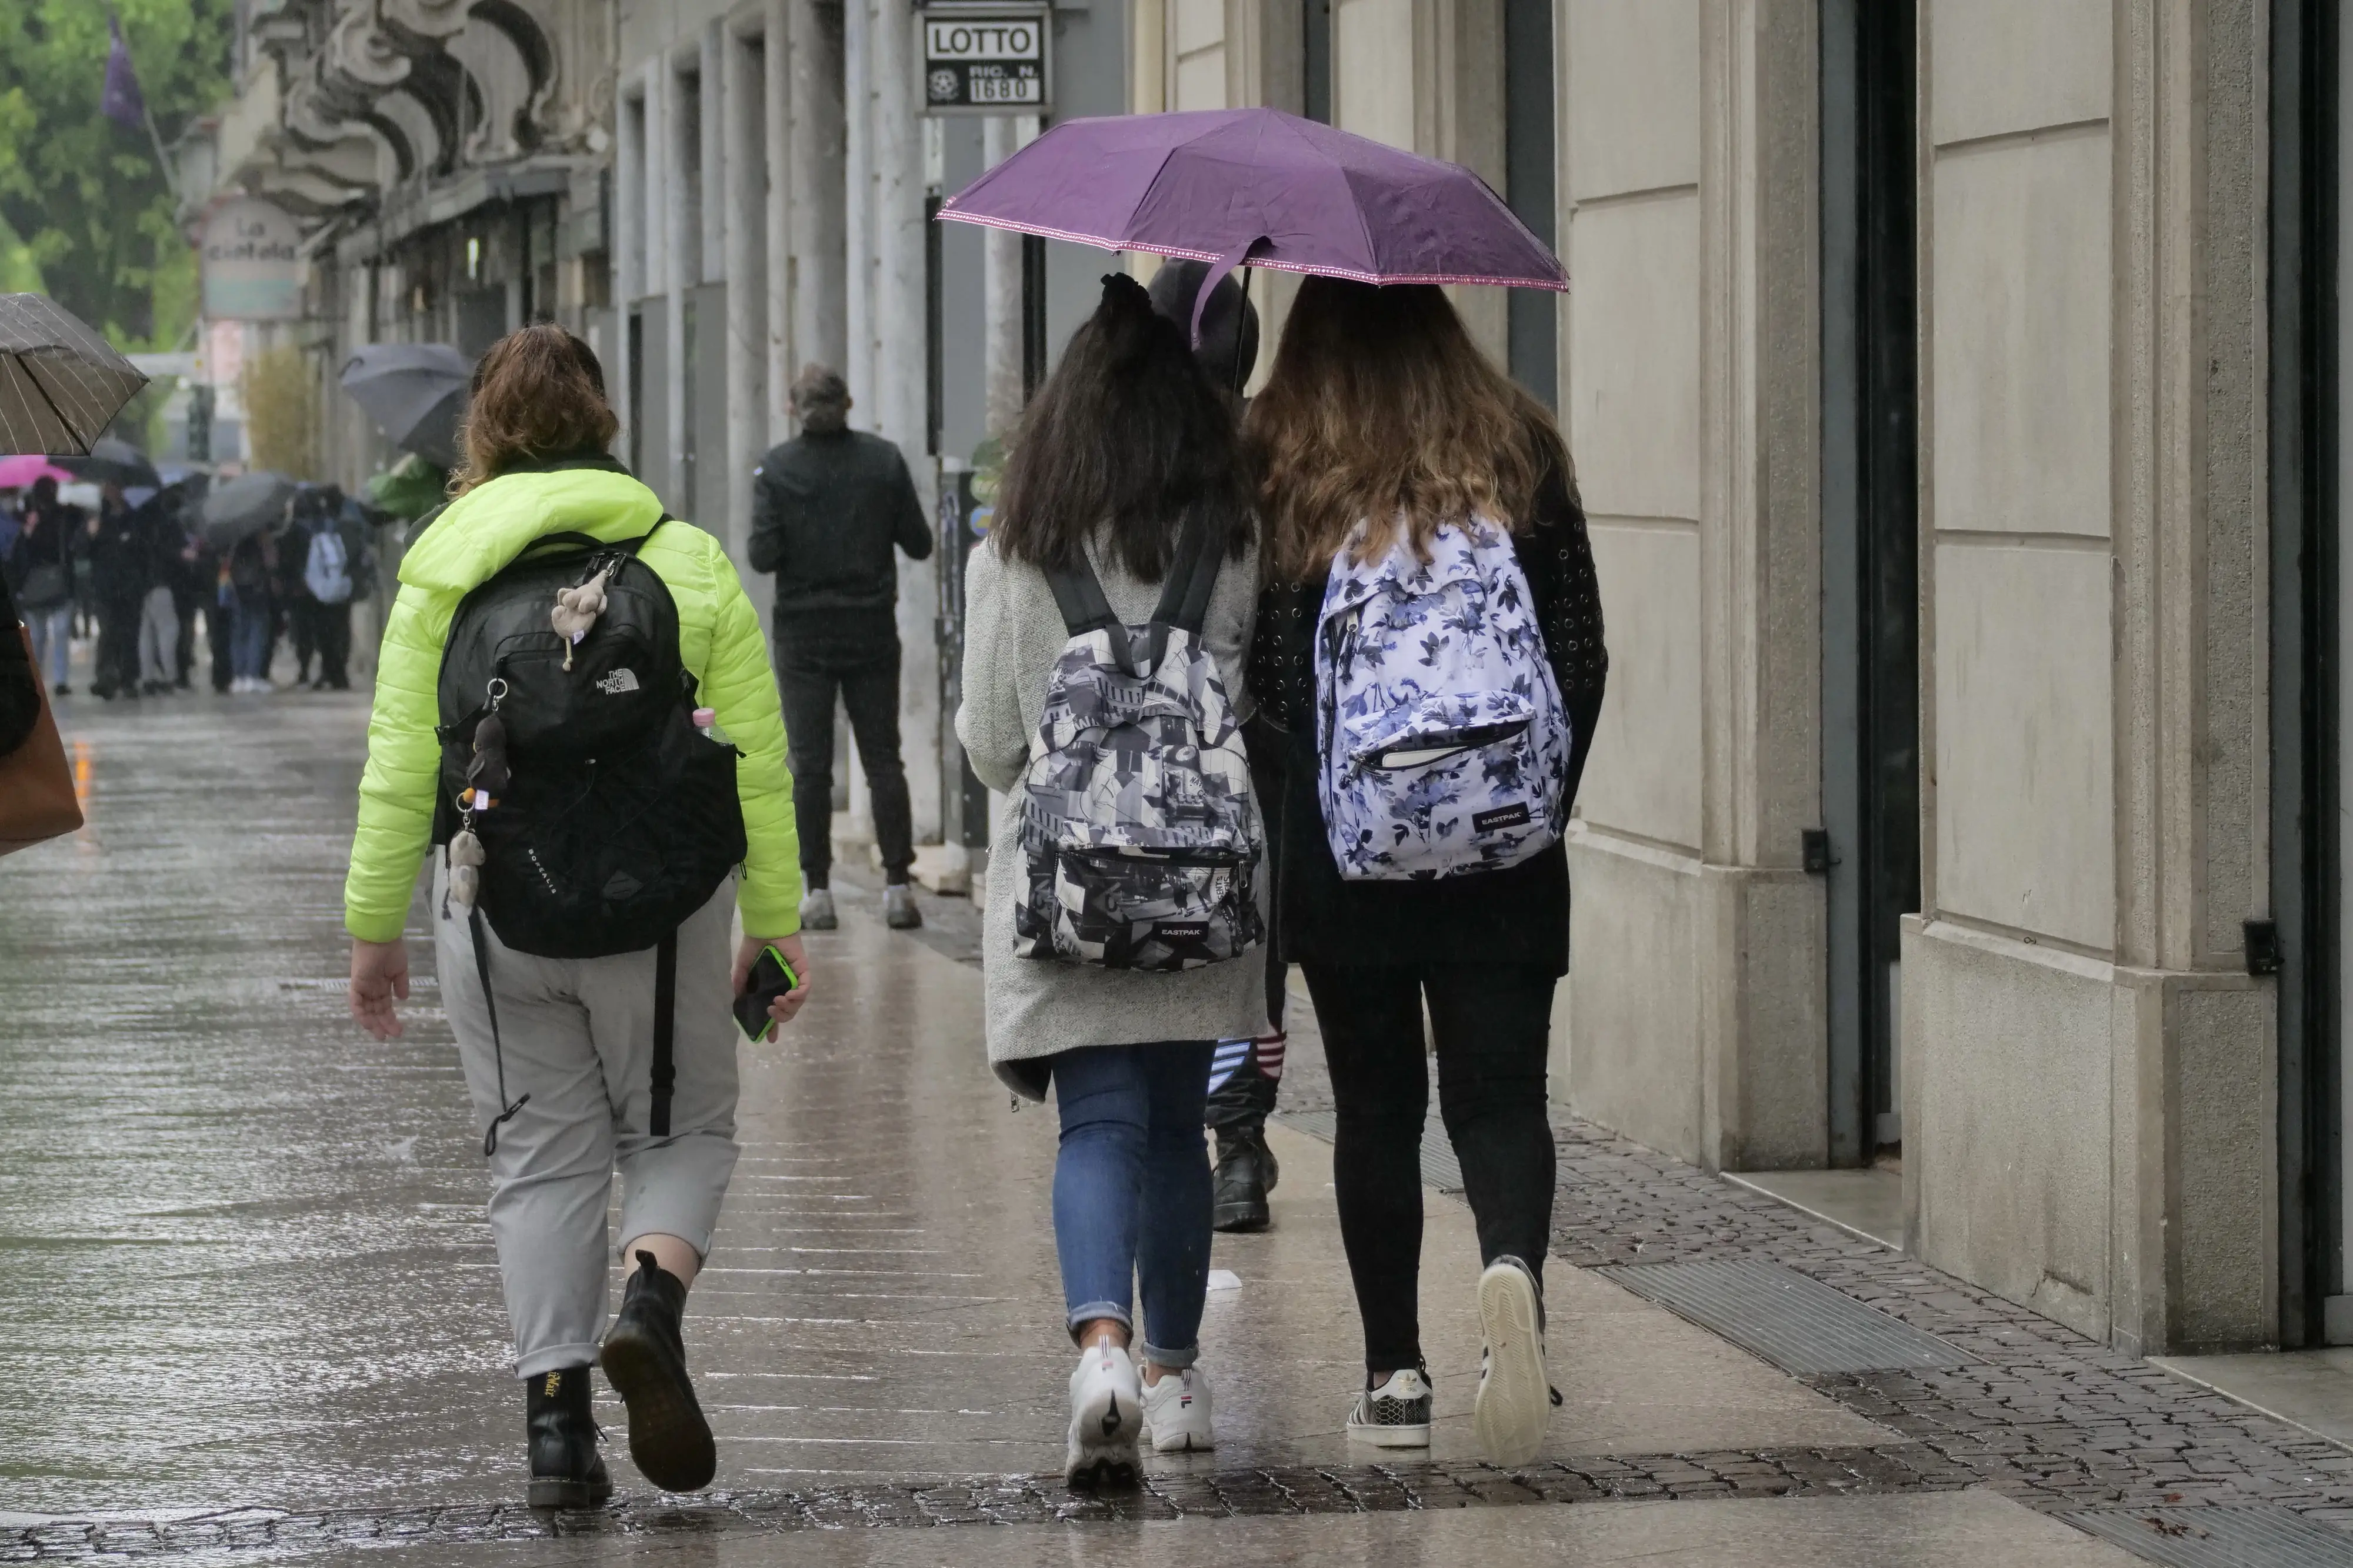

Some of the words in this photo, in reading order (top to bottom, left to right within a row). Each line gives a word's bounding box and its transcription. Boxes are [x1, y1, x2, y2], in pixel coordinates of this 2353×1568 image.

[935, 28, 1031, 54] LOTTO
[975, 81, 1026, 99] 1680
[608, 669, 624, 678] THE
[596, 676, 624, 689] NORTH
[605, 683, 625, 695] FACE
[1481, 812, 1521, 825] EASTPAK
[528, 848, 556, 894] BOREALIS
